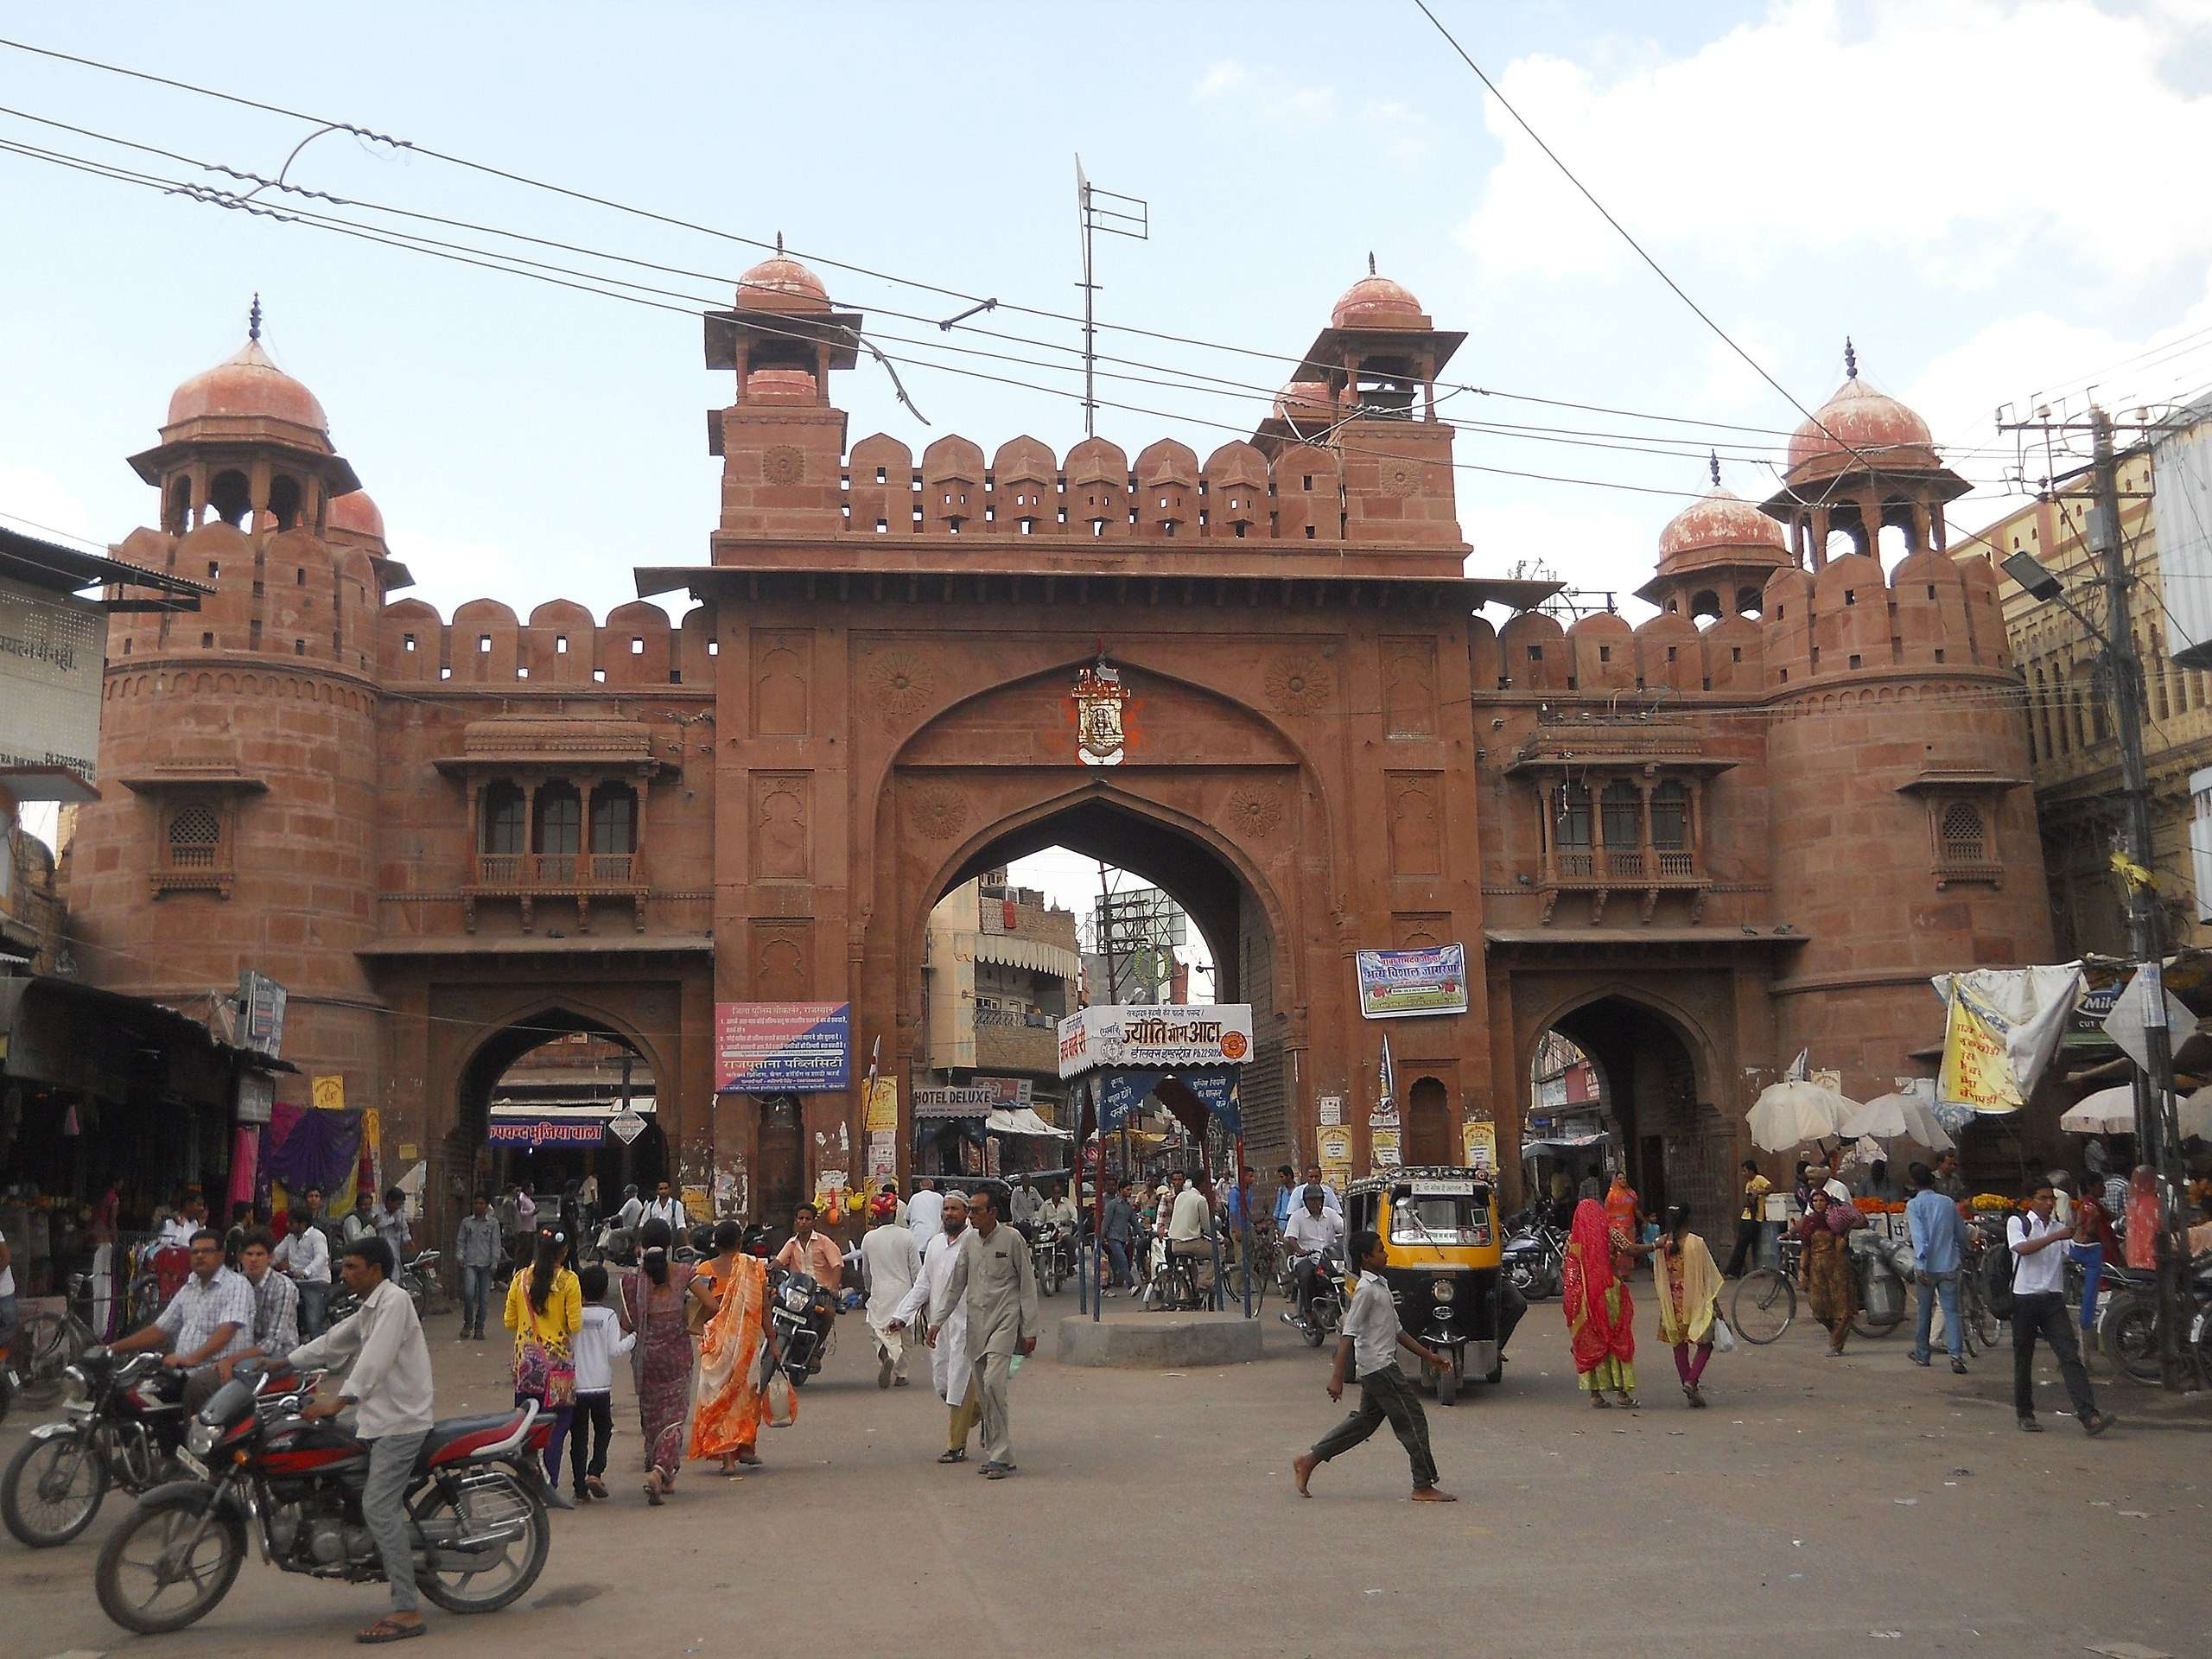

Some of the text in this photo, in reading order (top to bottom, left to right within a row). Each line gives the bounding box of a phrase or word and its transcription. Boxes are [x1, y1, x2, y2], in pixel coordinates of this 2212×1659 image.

[1388, 966, 1419, 978] विशाल
[1122, 1018, 1167, 1044] ज्योति
[1189, 1020, 1222, 1043] आटा
[784, 1056, 843, 1068] पब्लिसिटी
[915, 1090, 947, 1103] HOTEL
[950, 1090, 991, 1103] DELUXE
[529, 1121, 570, 1146] भुजिया
[571, 1125, 603, 1140] वाला
